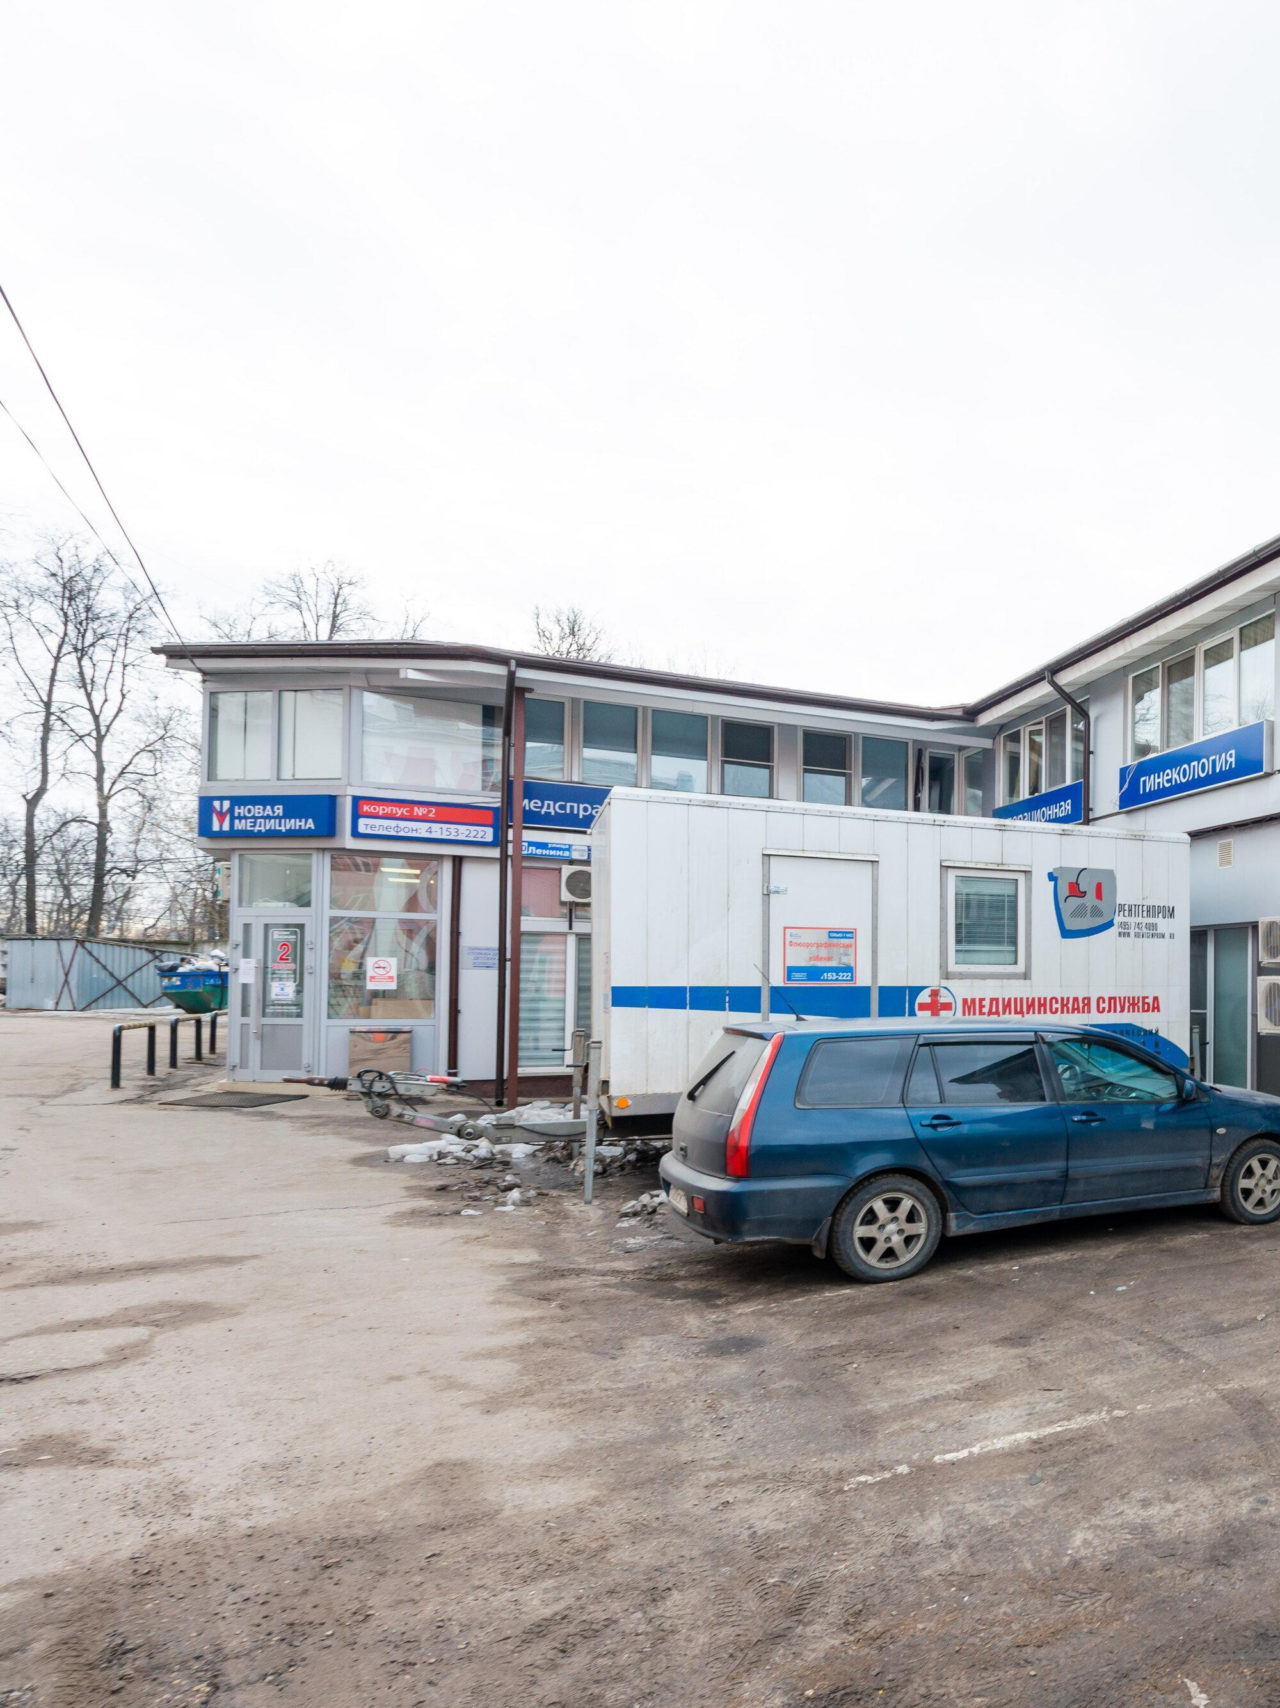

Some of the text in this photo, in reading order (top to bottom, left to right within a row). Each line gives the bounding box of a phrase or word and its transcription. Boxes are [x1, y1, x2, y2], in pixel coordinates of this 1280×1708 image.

[1139, 749, 1236, 795] гинекология
[234, 805, 284, 817] НОВАЯ
[362, 804, 436, 818] корпус №2
[234, 818, 316, 833] МЕДИЦИНА
[363, 823, 488, 840] телефон: 4-153-222
[527, 846, 570, 857] Ленина
[1117, 903, 1175, 919] РЕНТГЕНПРОМ
[277, 942, 291, 962] 2
[961, 995, 1161, 1018] МЕДИЦИНСКАЯ СЛУЖБА
